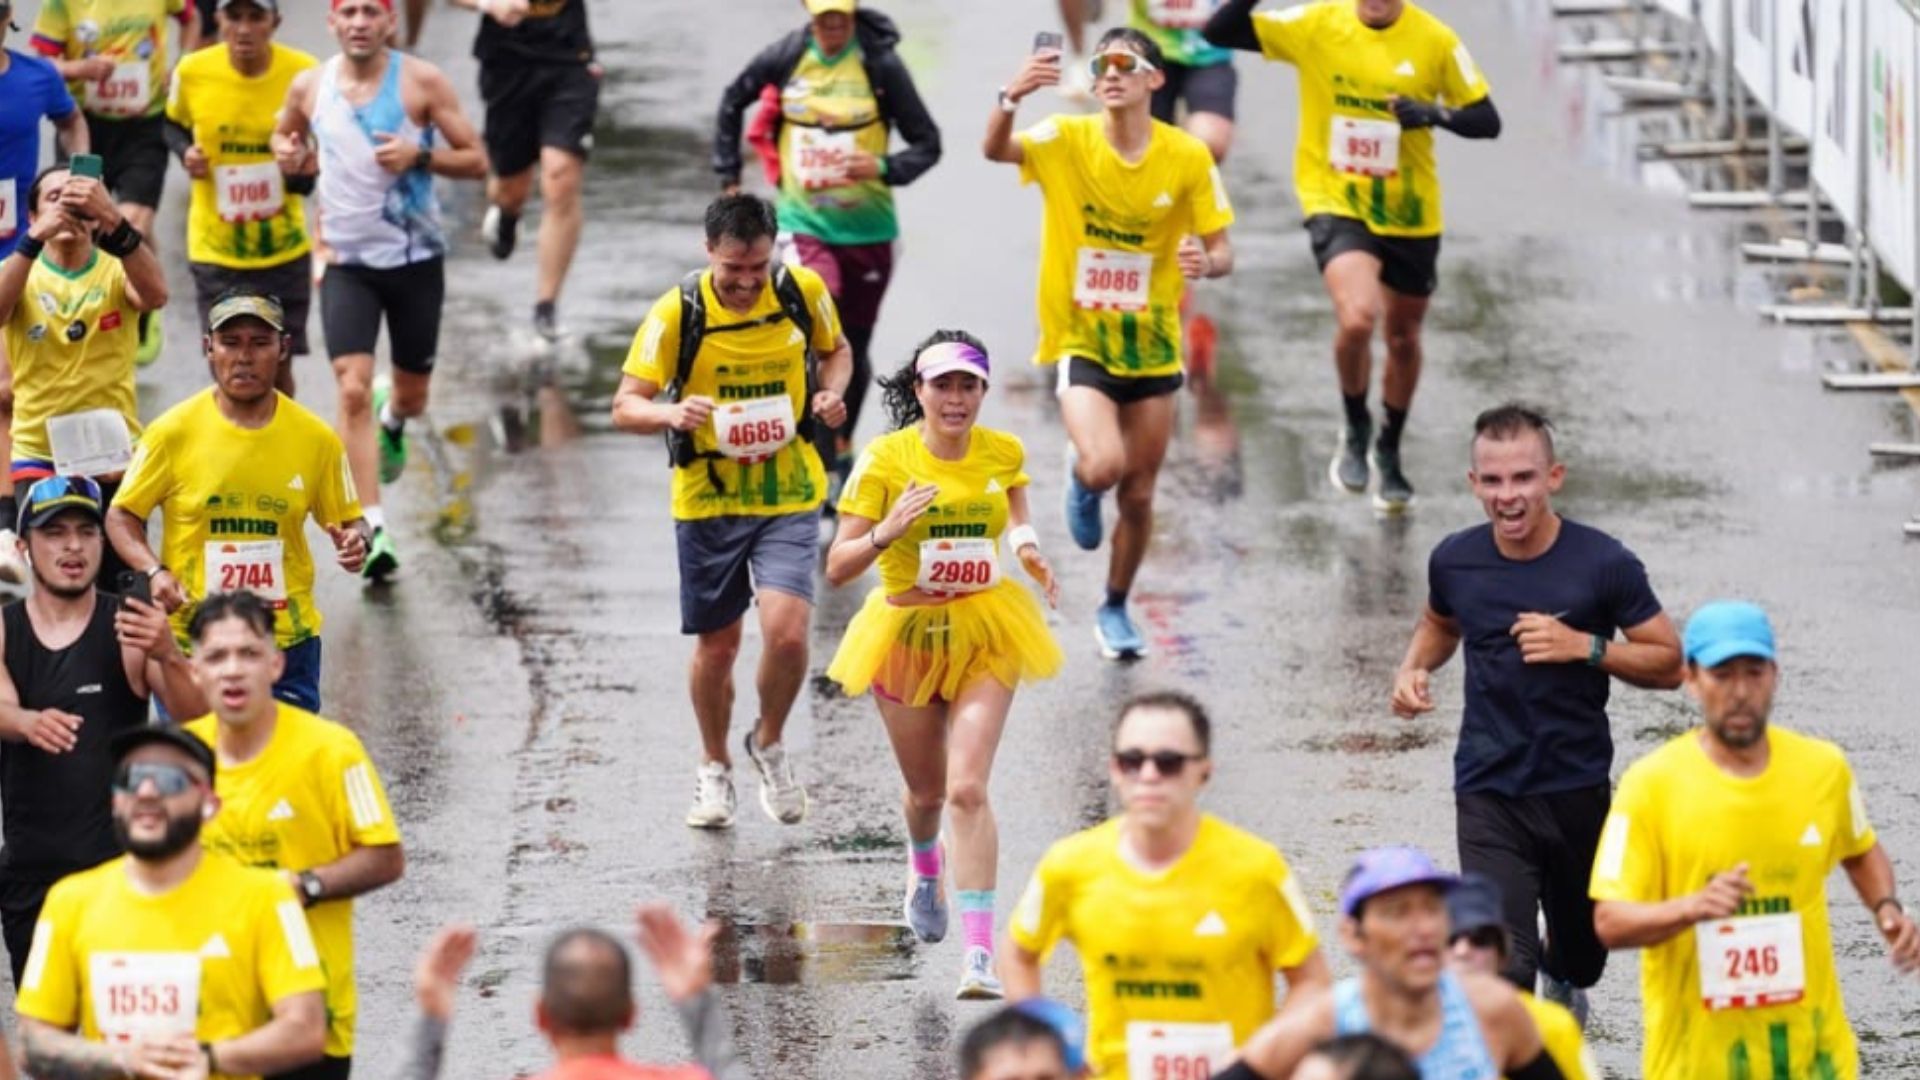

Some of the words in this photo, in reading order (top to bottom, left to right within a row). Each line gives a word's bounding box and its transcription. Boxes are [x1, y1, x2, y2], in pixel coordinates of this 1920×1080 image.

[1086, 268, 1139, 292] 3086
[727, 418, 785, 447] 4685
[220, 563, 274, 590] 2744
[929, 560, 990, 585] 2980
[1725, 945, 1778, 979] 246
[109, 985, 179, 1016] 1553
[1152, 1054, 1209, 1080] 990
